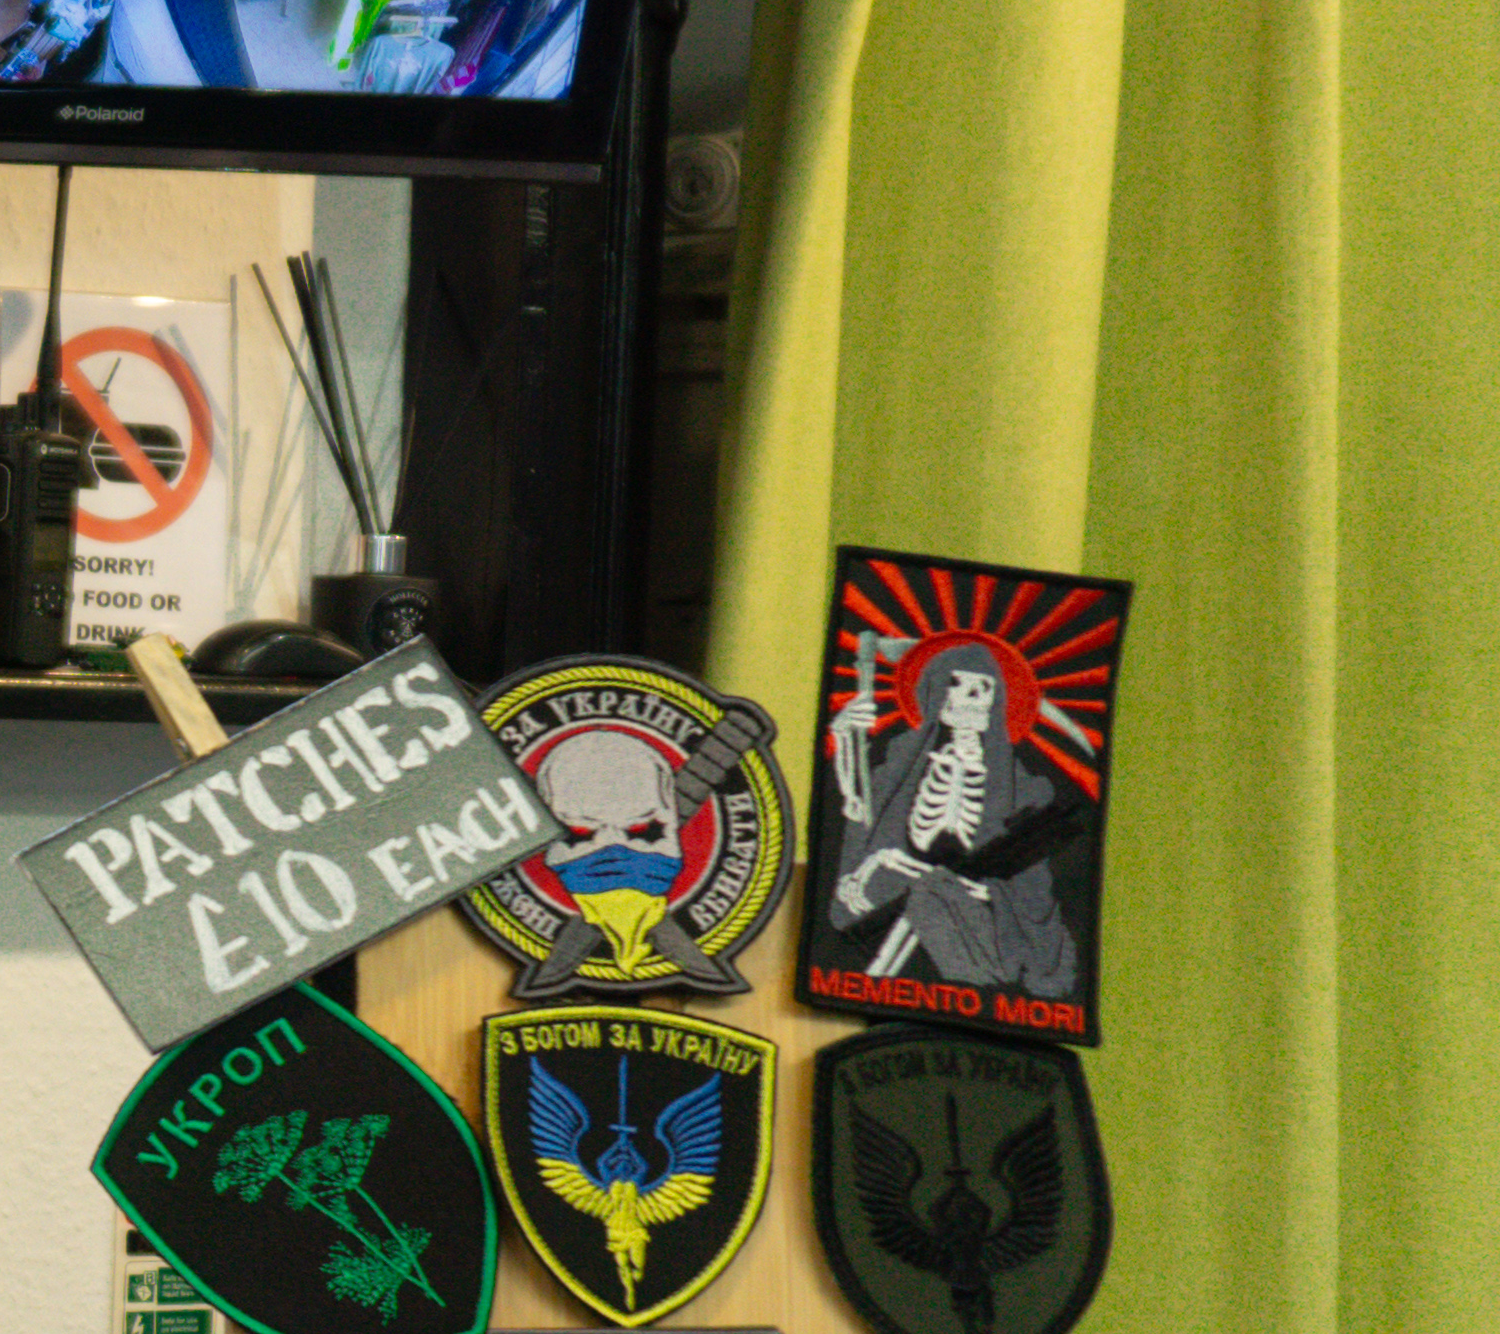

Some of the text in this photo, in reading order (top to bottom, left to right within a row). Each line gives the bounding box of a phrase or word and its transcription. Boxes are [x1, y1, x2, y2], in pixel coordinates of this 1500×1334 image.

[75, 105, 145, 122] Polaroid
[72, 555, 155, 576] SORRY!
[82, 589, 143, 609] FOOD
[150, 593, 182, 612] OR
[75, 622, 146, 642] DRINK
[500, 690, 705, 754] ЗА УКРАЇНУ
[64, 662, 474, 924] PATCHES
[187, 777, 542, 993] £10 EACH
[809, 966, 1086, 1034] MEMENTO MORI
[499, 1020, 762, 1076] З БОГОМ ЗА УКРАЇНУ
[137, 1016, 309, 1180] УКРОП
